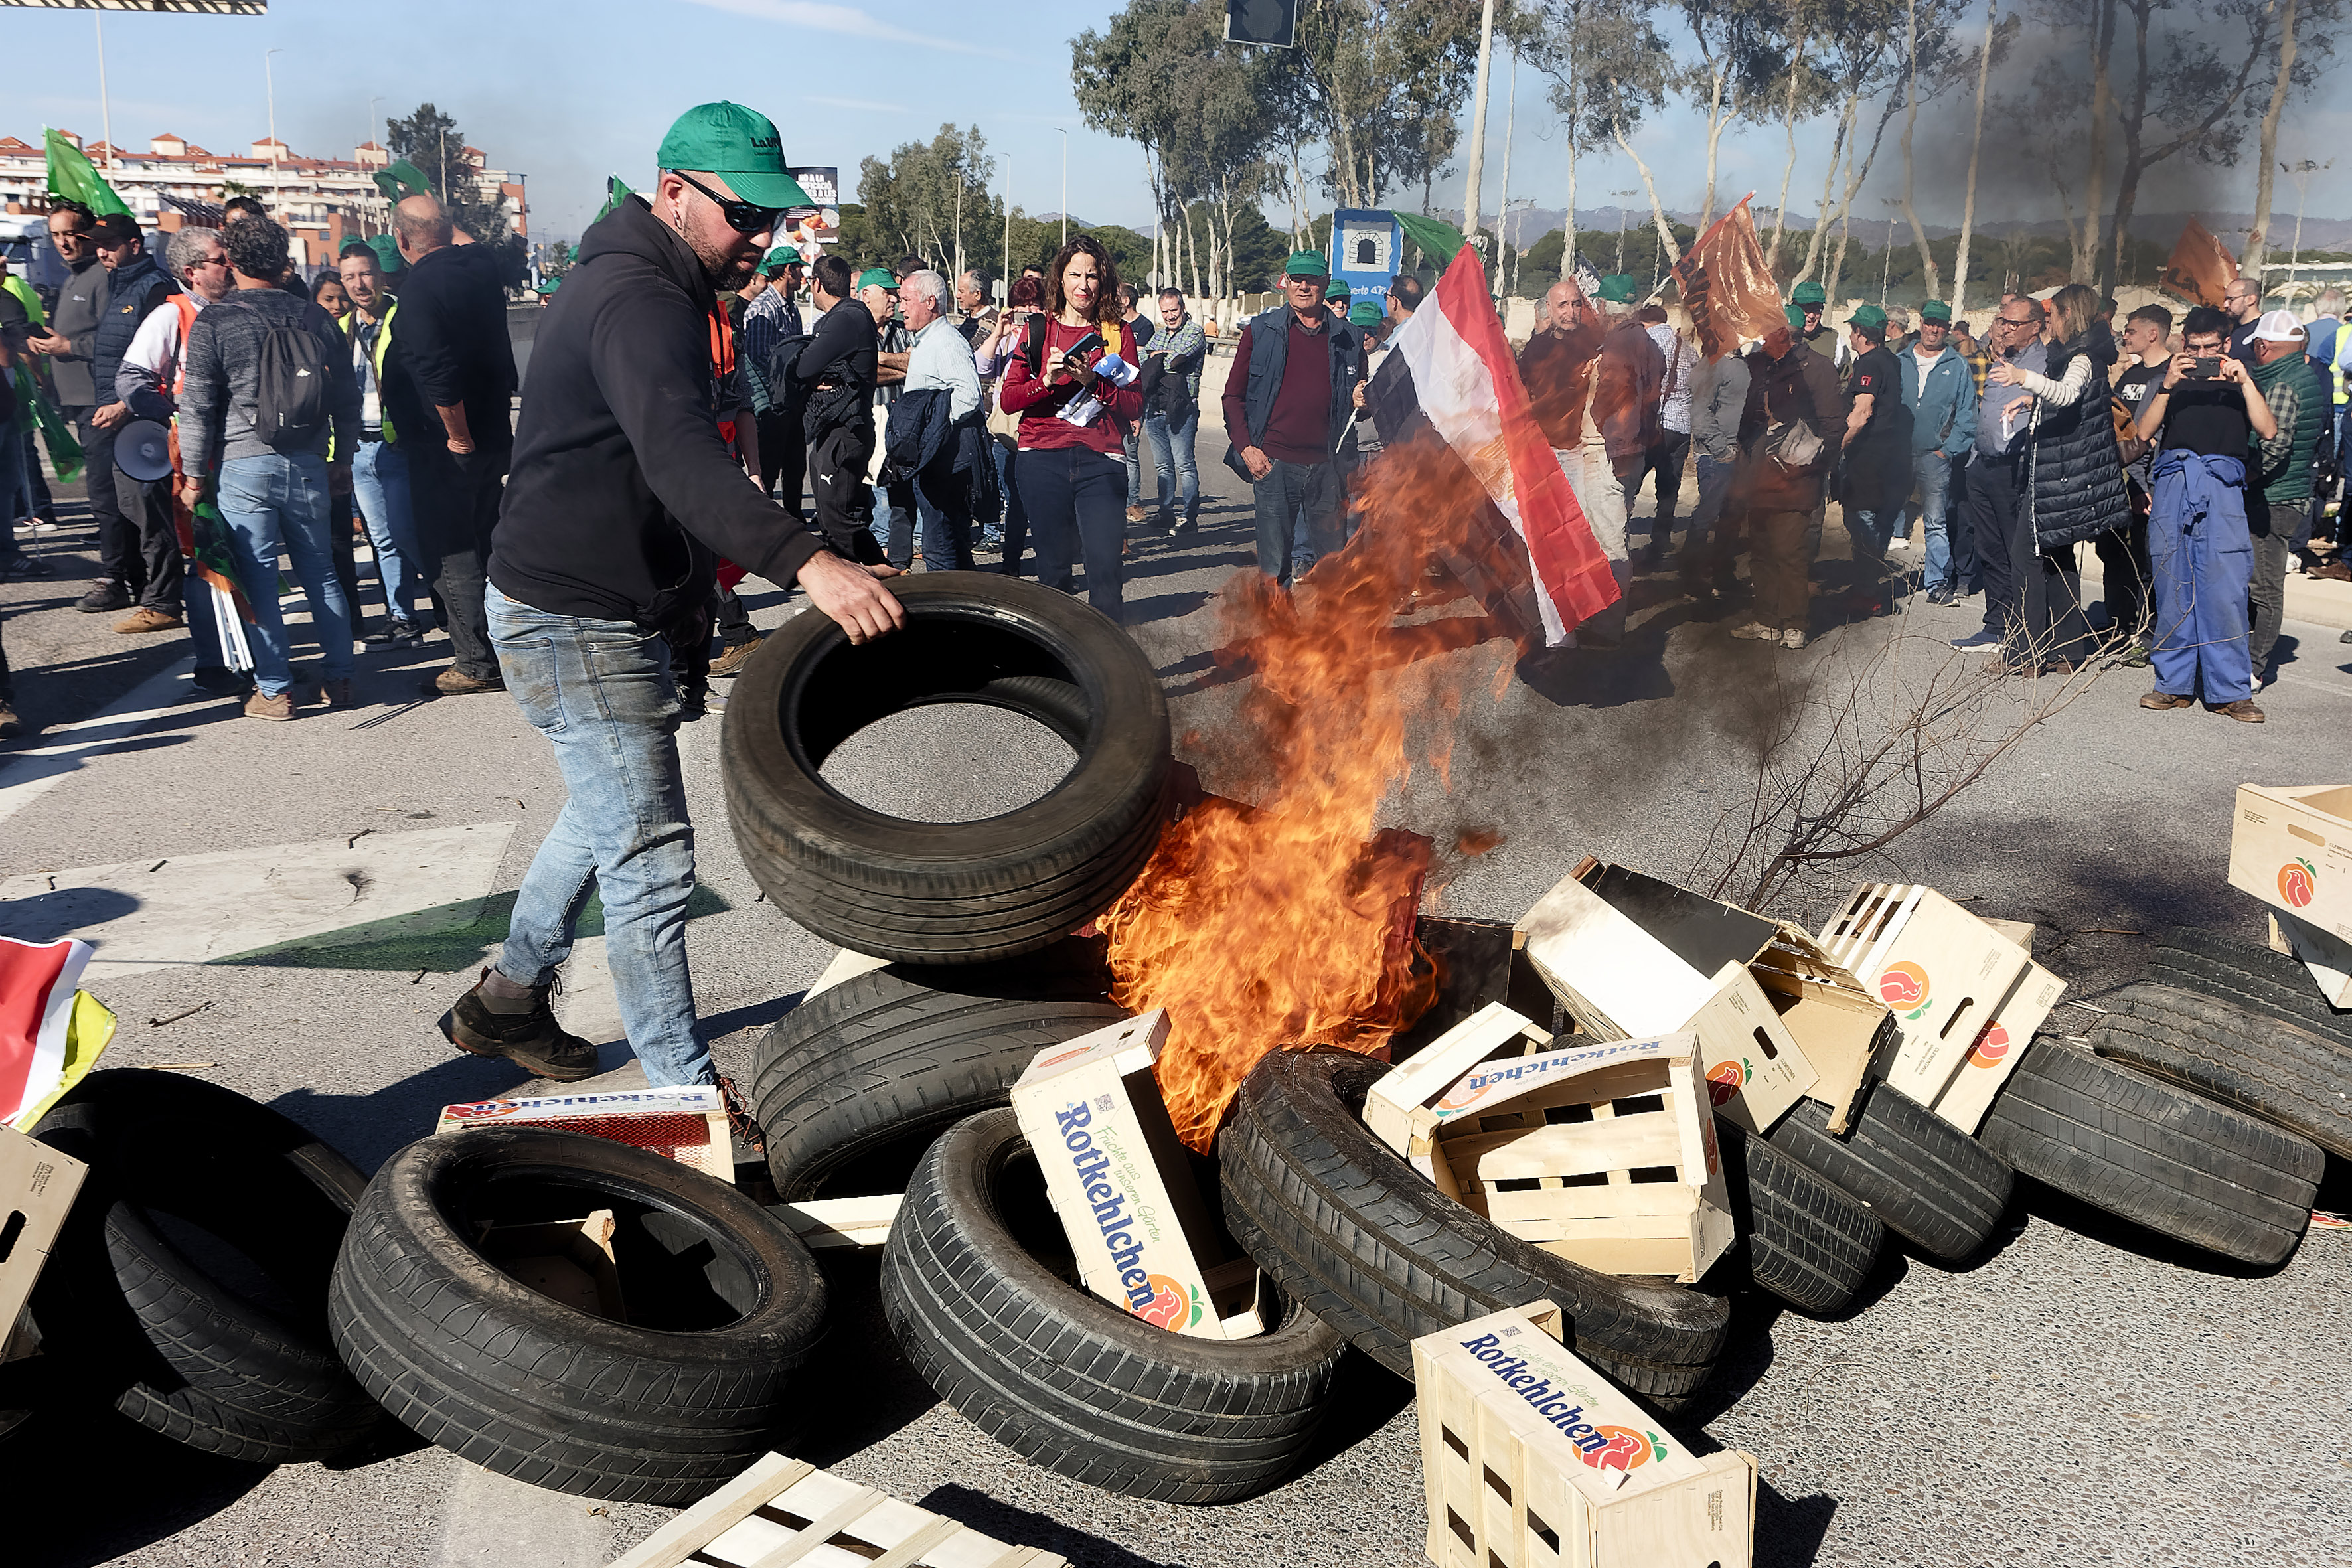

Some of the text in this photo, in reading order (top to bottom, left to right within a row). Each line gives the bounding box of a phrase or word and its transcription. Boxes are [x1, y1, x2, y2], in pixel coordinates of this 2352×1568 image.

[809, 173, 815, 182] A
[815, 173, 824, 182] LA
[1469, 1041, 1662, 1091] Rotkehlchen
[473, 1093, 707, 1113] Rotkehlchen
[1094, 1125, 1140, 1180] Früchte aus
[1055, 1101, 1156, 1310] Rotkehlchen
[1114, 1170, 1160, 1243] unseren Gärten
[1504, 1344, 1564, 1372] Früchte aus
[1461, 1333, 1609, 1453] Rotkehlchen
[1533, 1366, 1599, 1407] unseren Gärten
